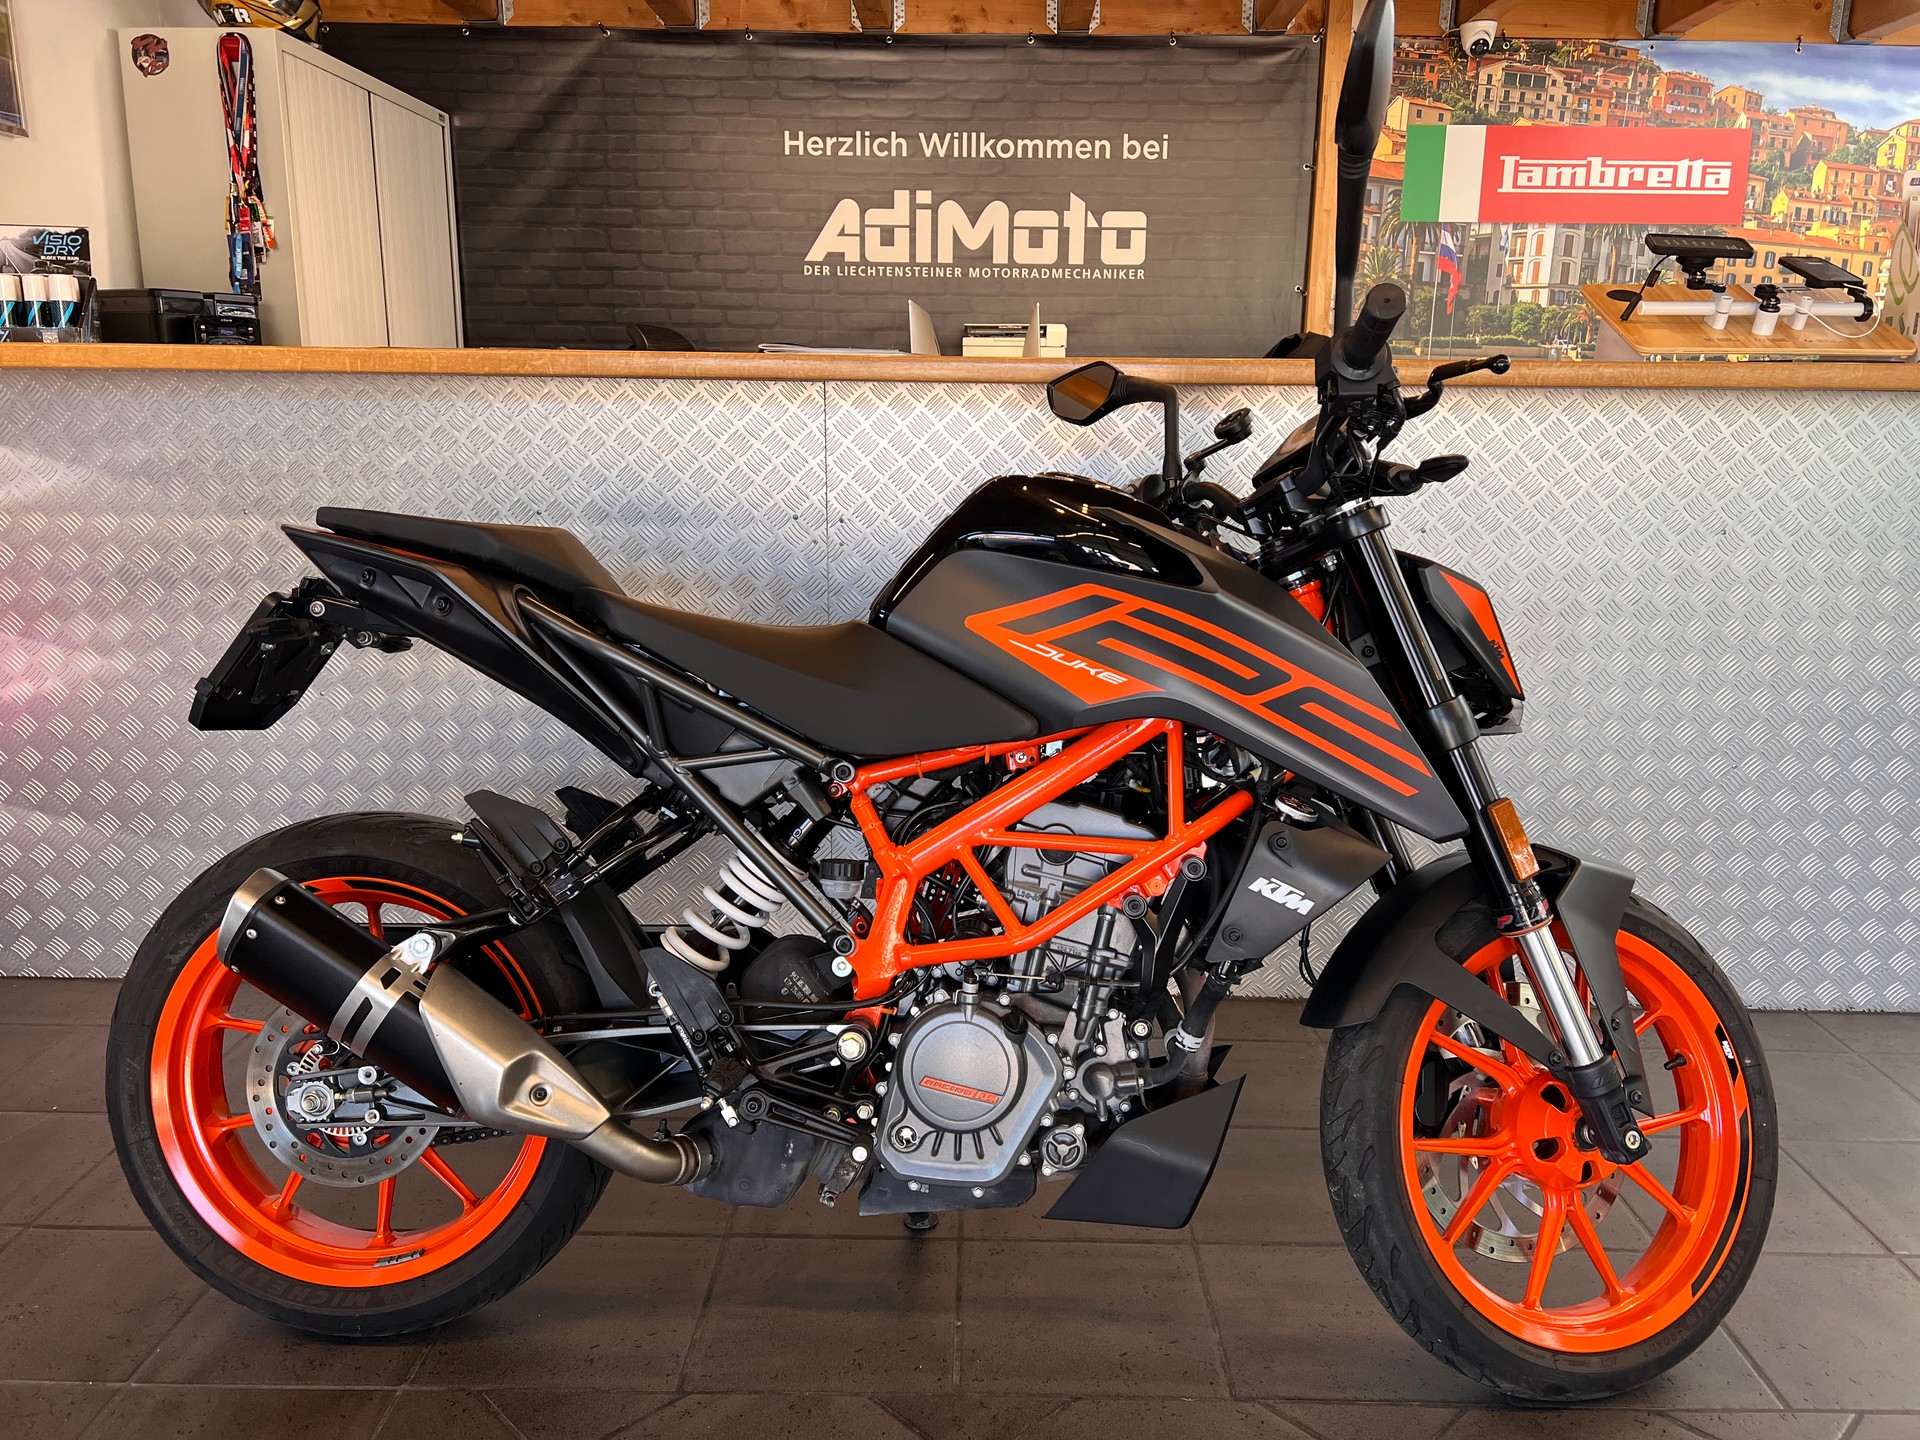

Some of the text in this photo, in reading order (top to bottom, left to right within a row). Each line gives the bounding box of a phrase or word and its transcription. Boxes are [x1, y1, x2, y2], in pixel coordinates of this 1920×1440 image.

[783, 130, 1169, 160] Herzlich Willkommen bei
[1497, 155, 1732, 195] Lambretta
[33, 229, 82, 246] VISIO
[804, 189, 1147, 266] AdiMoto
[44, 245, 80, 256] DRY
[803, 264, 1145, 280] DER LIECHTENSTEINER MOTORRADMECHANIKER
[1008, 639, 1128, 685] DUKE
[1248, 876, 1315, 916] KTM
